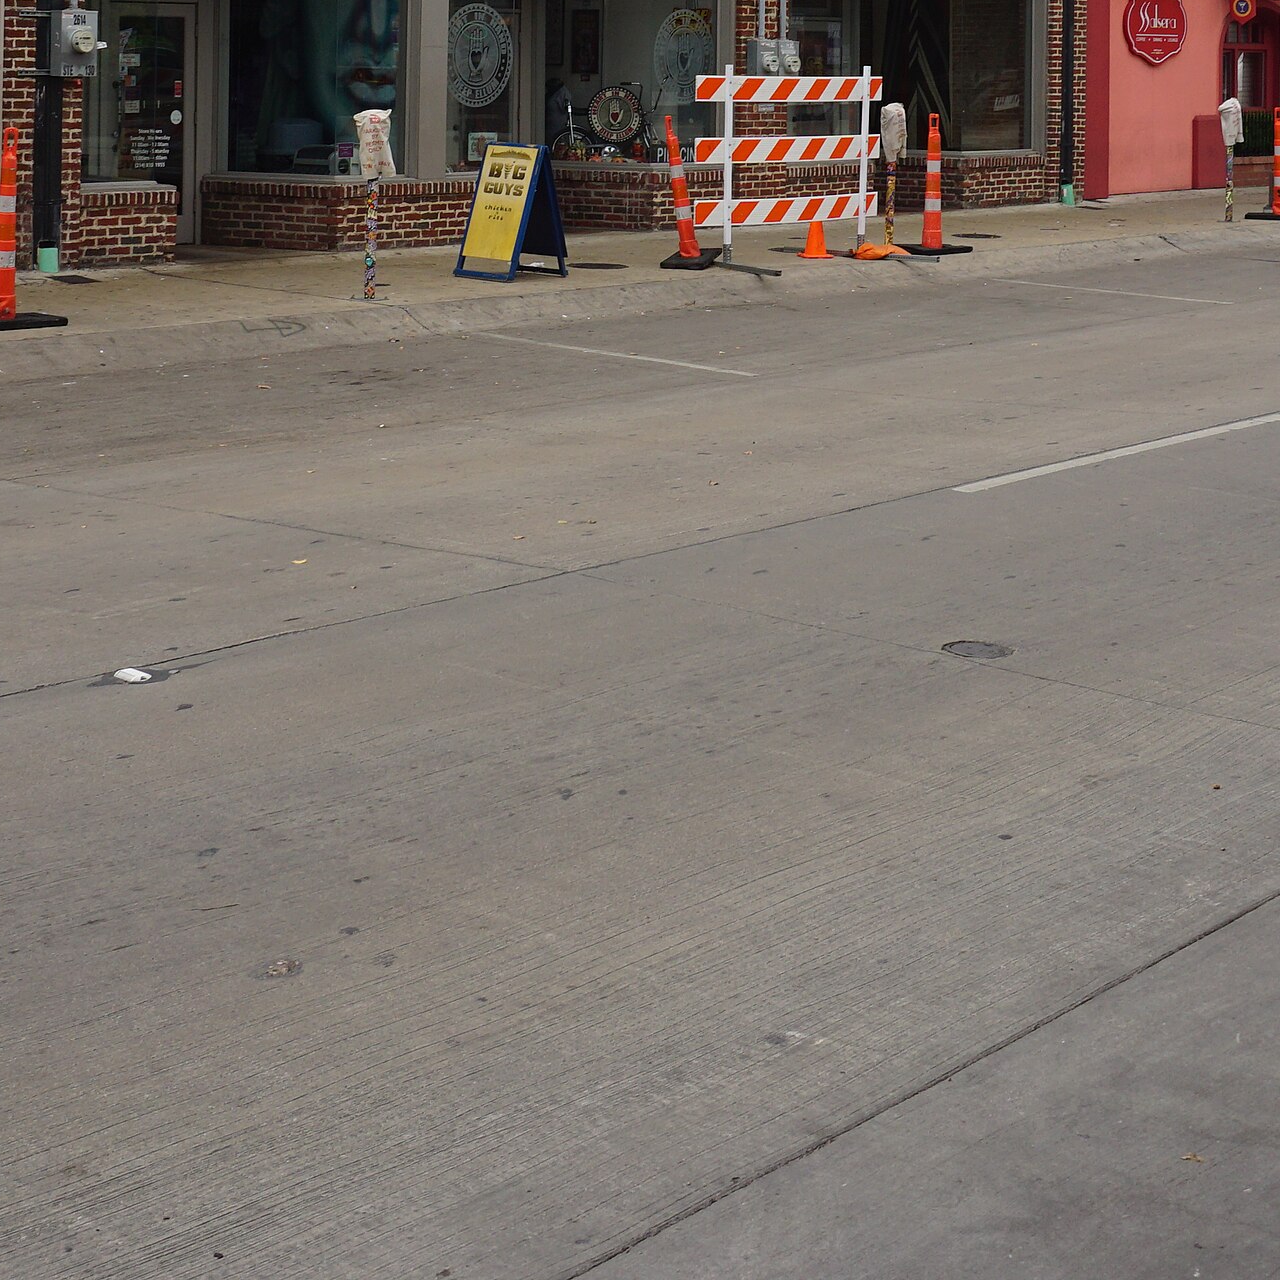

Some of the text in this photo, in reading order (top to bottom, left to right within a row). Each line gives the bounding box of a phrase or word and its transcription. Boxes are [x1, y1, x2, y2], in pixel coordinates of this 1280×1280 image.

[73, 14, 86, 26] 2614
[63, 65, 95, 76] STE 130
[657, 147, 695, 162] PICIN
[483, 182, 524, 196] GUYS
